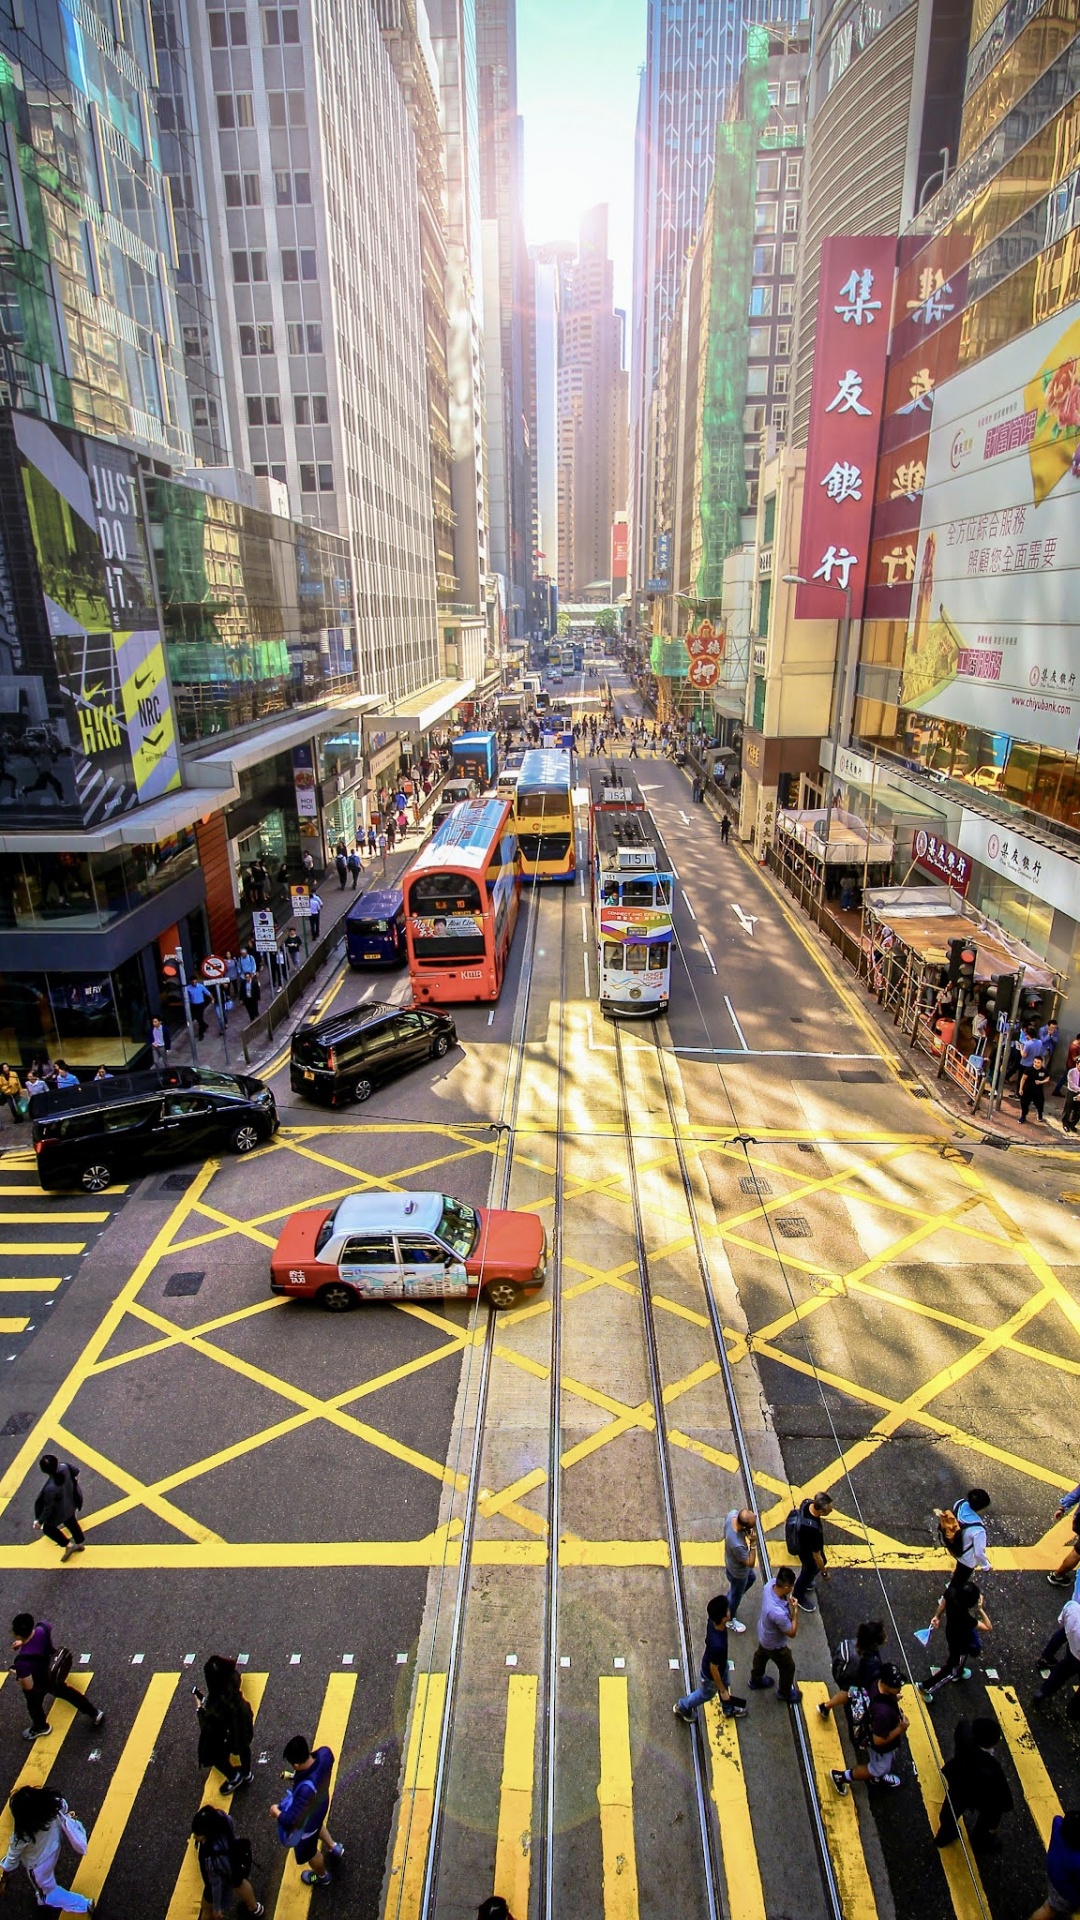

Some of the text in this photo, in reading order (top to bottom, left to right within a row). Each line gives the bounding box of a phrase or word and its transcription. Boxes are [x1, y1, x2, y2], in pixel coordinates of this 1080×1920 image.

[813, 268, 881, 589] 集友銀行
[984, 410, 1037, 459] 財富管理
[92, 465, 137, 516] JUST
[99, 517, 126, 561] DO
[947, 506, 1027, 546] 全方位綜合服務
[967, 538, 1058, 574] 照顧您全面需要
[106, 567, 132, 608] IT.
[693, 661, 716, 684] 押
[957, 650, 1002, 679] 工商服務
[138, 696, 161, 727] NRC
[1011, 696, 1071, 715] www.chiyubank.com
[78, 704, 121, 755] HKG
[628, 854, 647, 864] 151
[1000, 842, 1042, 878] 集友銀行
[461, 970, 482, 979] KMB
